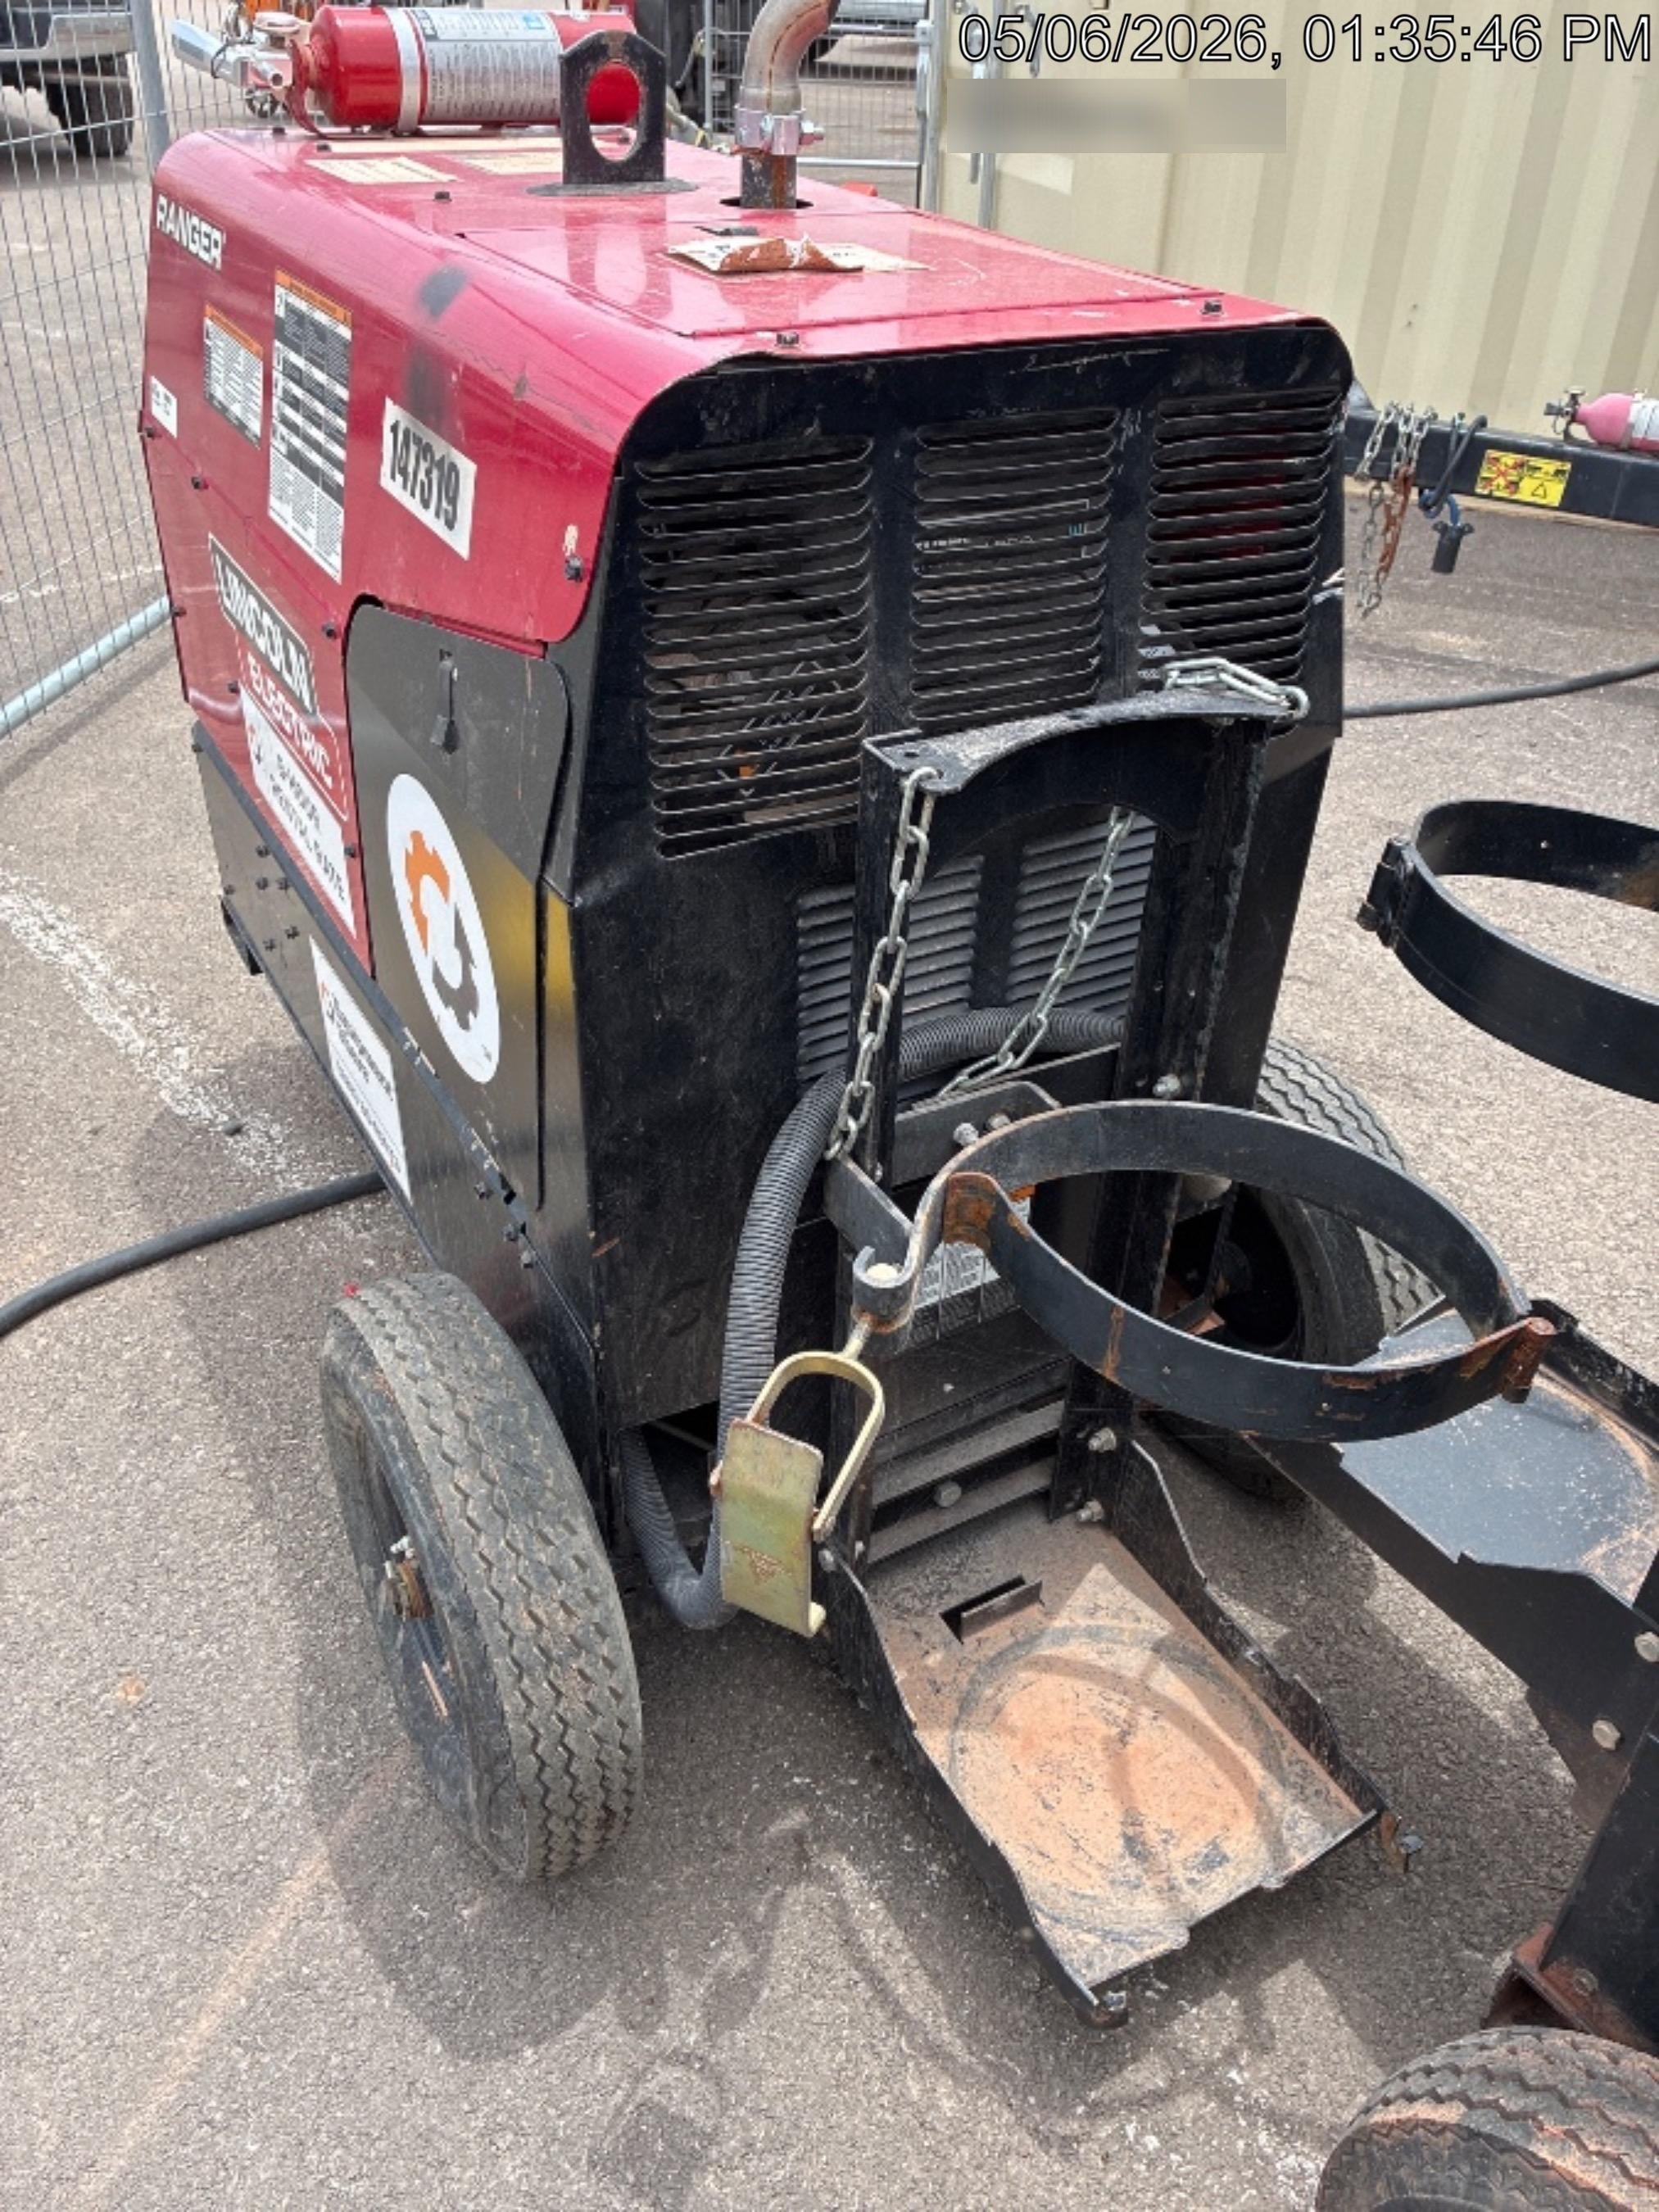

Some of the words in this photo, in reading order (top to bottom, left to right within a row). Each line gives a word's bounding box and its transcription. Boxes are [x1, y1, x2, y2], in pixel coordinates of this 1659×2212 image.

[156, 194, 223, 270] RANGER
[389, 420, 460, 532] 147319
[215, 552, 313, 714] LINCOLN
[247, 651, 333, 790] ELECTRIC
